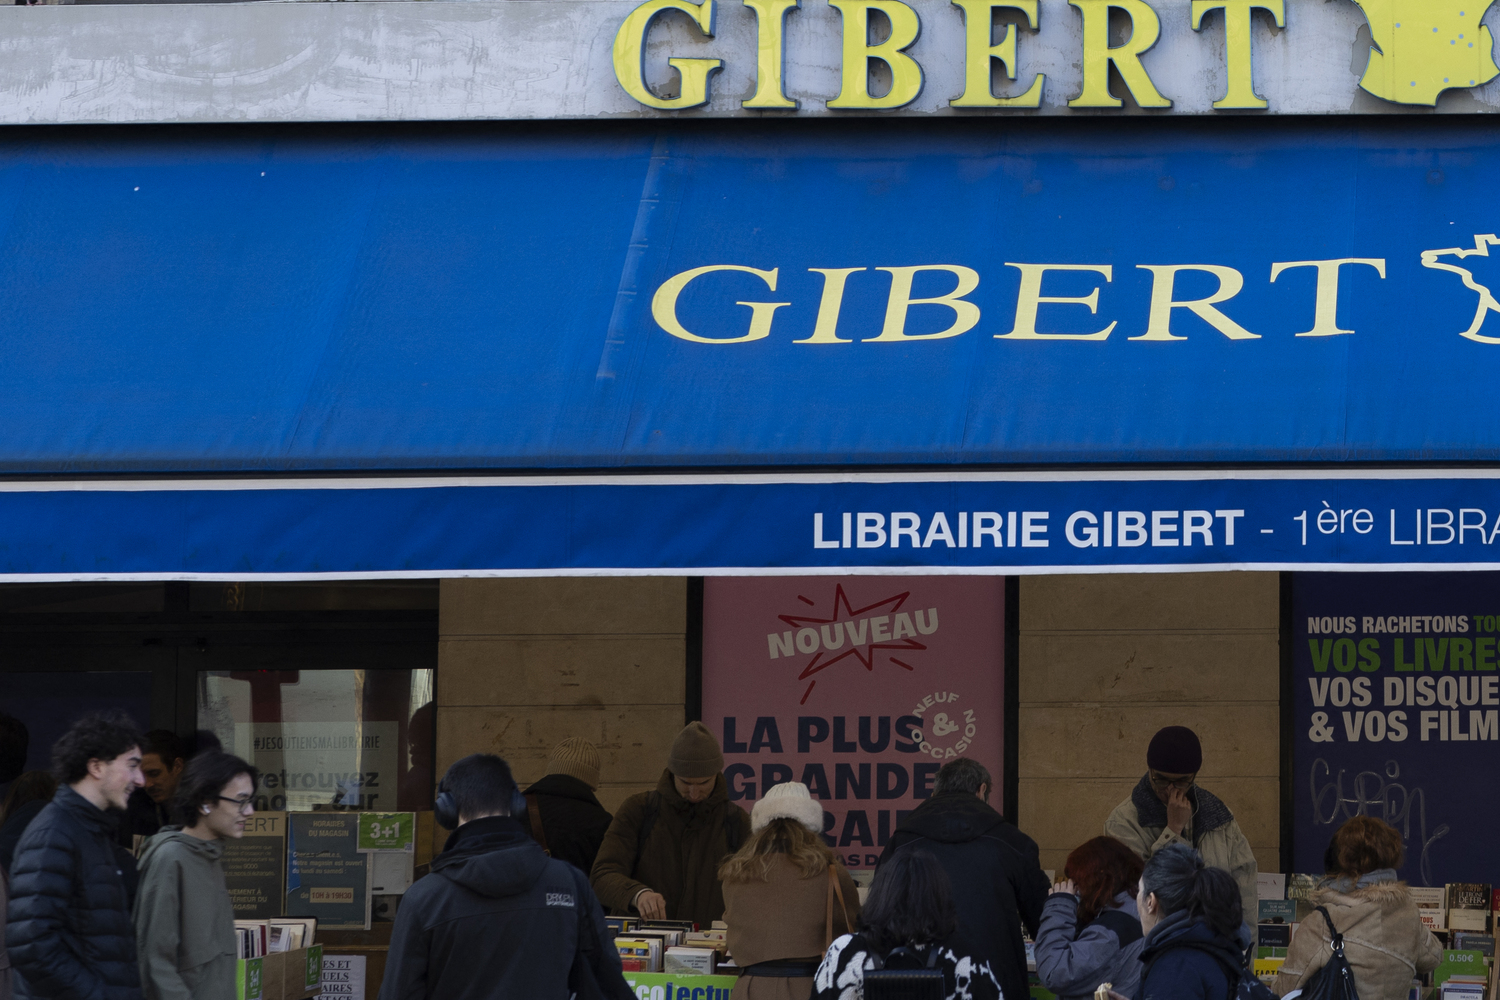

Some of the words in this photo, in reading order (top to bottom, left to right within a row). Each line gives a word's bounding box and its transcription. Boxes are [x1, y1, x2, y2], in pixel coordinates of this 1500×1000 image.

[651, 258, 1386, 345] GIBERT
[812, 510, 1050, 549] LIBRAIRIE
[1065, 508, 1245, 548] GIBERT
[1292, 501, 1375, 546] 1ère
[767, 608, 939, 659] NOUVEAU
[1307, 616, 1357, 634] NOUS
[1362, 615, 1469, 634] RACHETONS
[1308, 638, 1381, 672] VOS
[912, 691, 959, 718] NEUF
[1308, 676, 1372, 707] VOS
[723, 716, 783, 754] LA
[797, 715, 925, 754] PLUS
[911, 709, 976, 759] OCCASION
[933, 712, 959, 736] &
[1308, 711, 1335, 742] &
[1342, 710, 1408, 742] VOS
[253, 735, 380, 750] #JESOUTIENSMALIBRAIRIE
[257, 771, 379, 789] retrouvez
[370, 822, 400, 839] 3+1
[338, 960, 351, 968] ET
[1449, 954, 1474, 962] 0.50€
